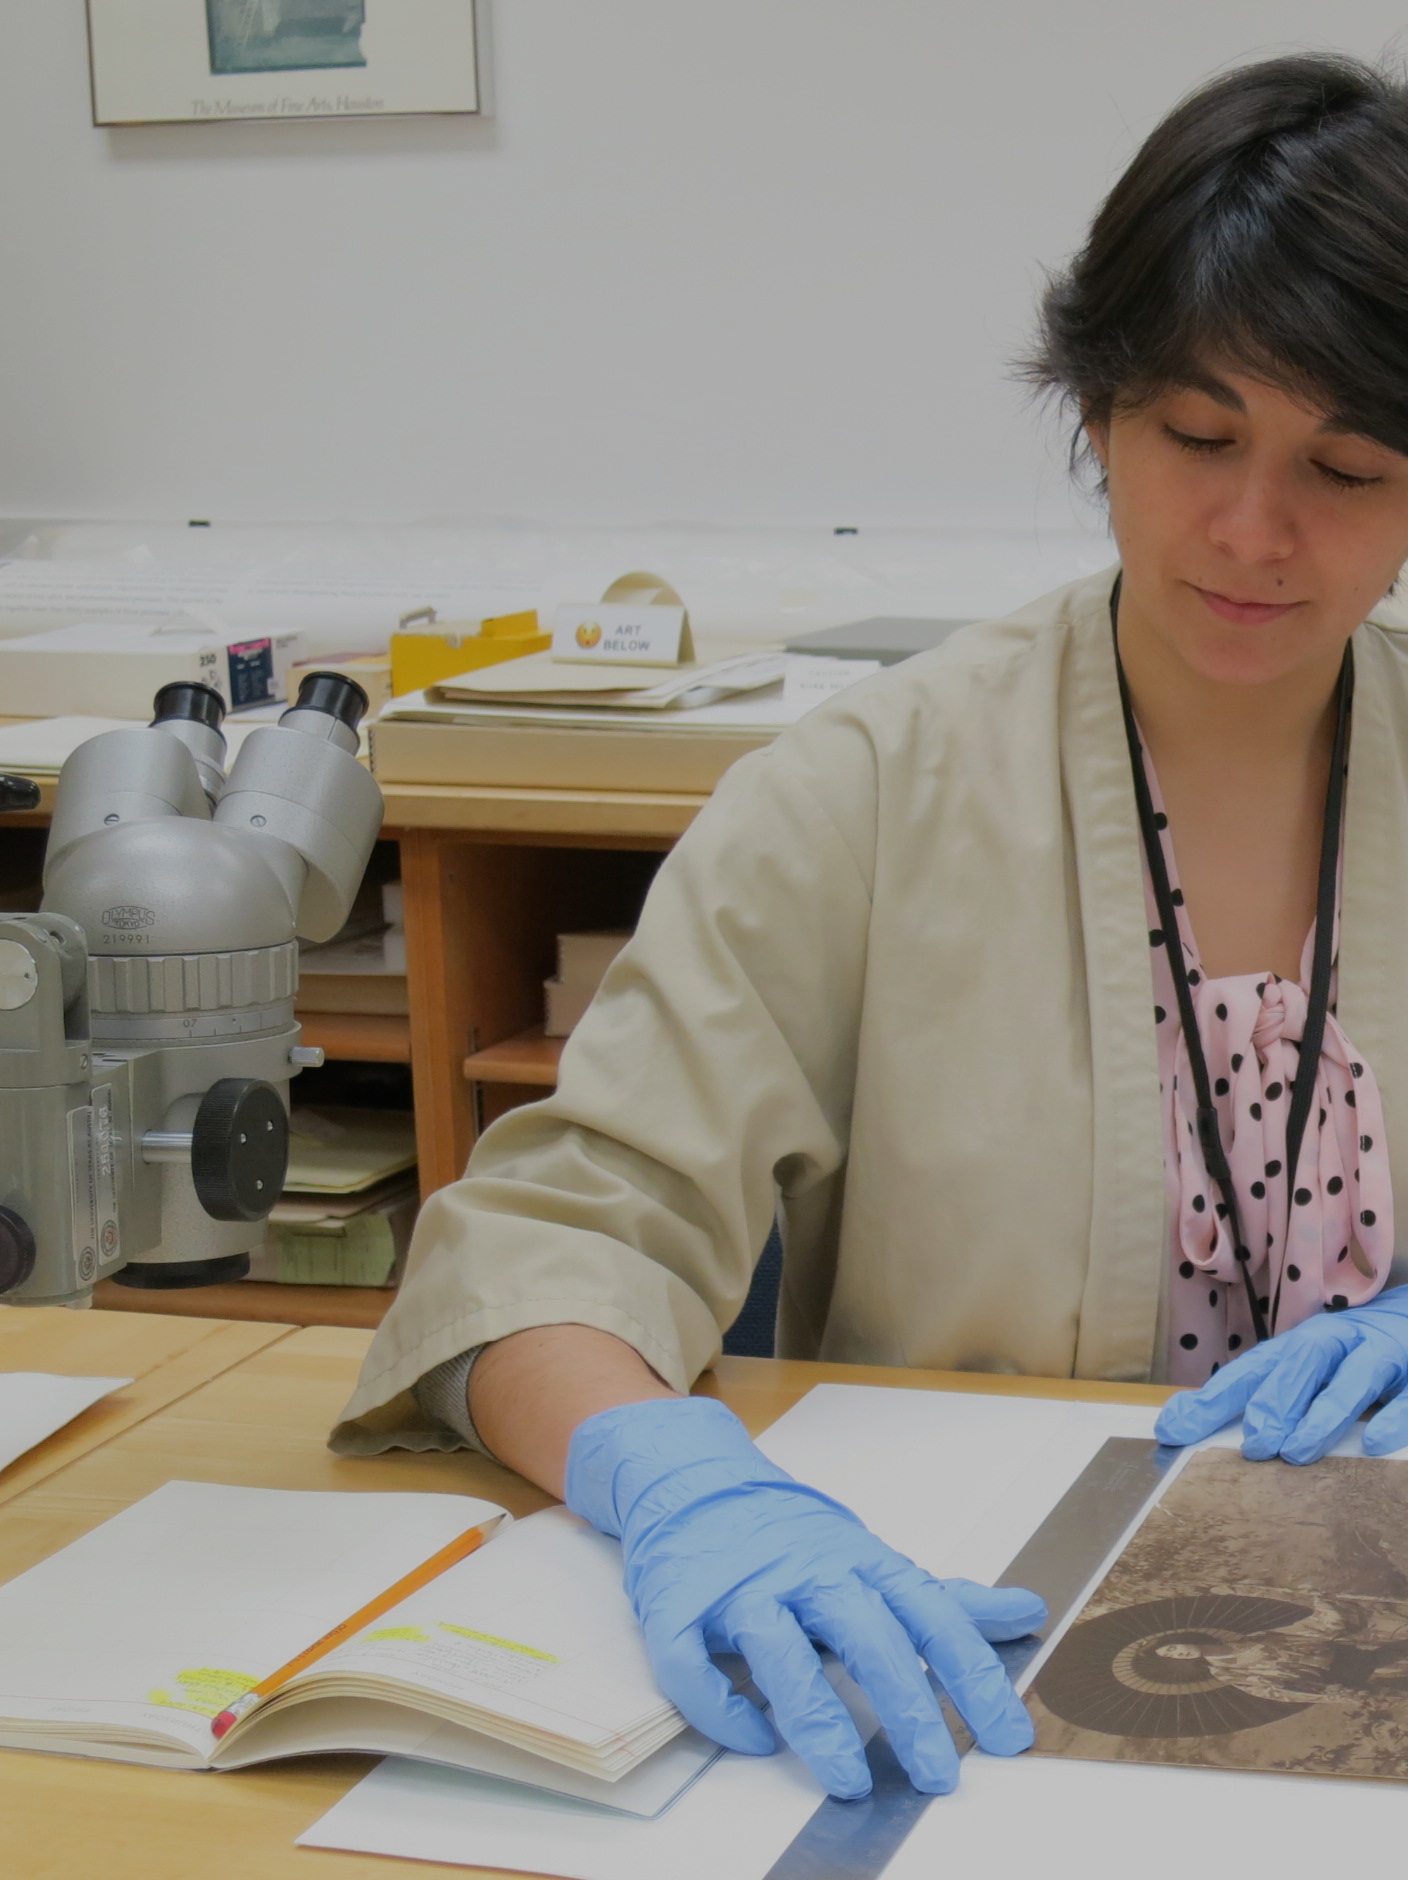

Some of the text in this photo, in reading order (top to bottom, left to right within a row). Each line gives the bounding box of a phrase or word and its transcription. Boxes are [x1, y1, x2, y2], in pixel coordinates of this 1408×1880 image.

[191, 99, 212, 116] The
[215, 99, 264, 114] Museum
[281, 97, 303, 112] Fine
[615, 625, 642, 636] ART
[603, 639, 650, 651] BELOW
[808, 669, 851, 677] CAUTION
[102, 907, 155, 926] OLYMPUS
[103, 934, 150, 945] 219991
[142, 1712, 202, 1734] THURSDAY
